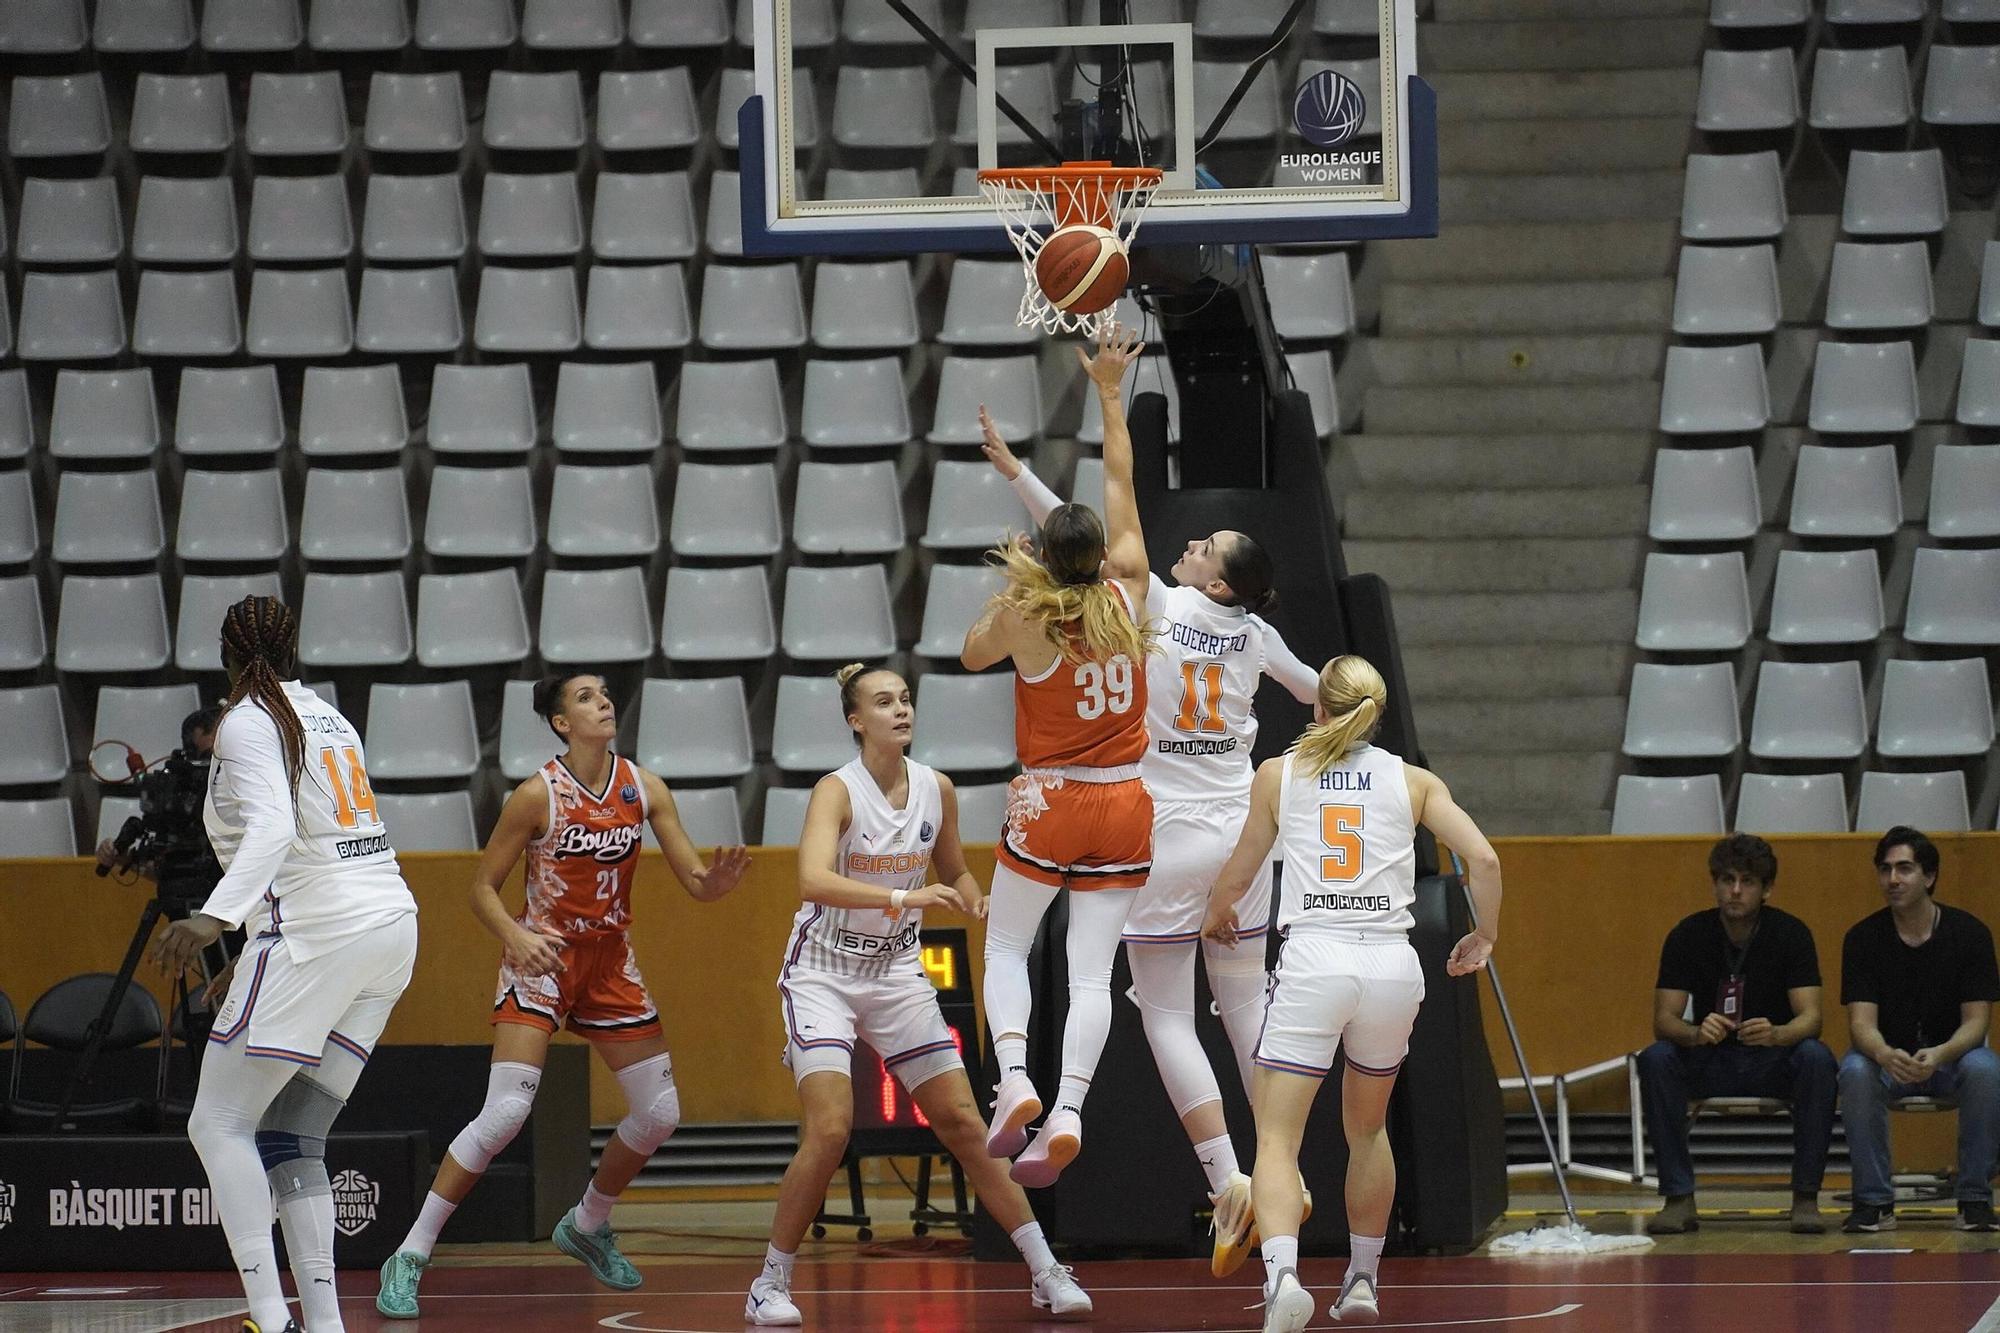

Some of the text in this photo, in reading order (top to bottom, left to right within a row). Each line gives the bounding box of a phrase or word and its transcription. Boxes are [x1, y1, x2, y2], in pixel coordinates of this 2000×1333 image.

[1280, 151, 1381, 168] EUROLEAGUE
[1301, 167, 1361, 182] WOMEN
[1074, 653, 1133, 721] 39
[1172, 660, 1228, 734] 11
[1158, 736, 1238, 756] BAUHAUS
[319, 745, 381, 831] 14
[1319, 771, 1372, 791] HOLM
[555, 822, 642, 863] Bourge
[1319, 803, 1365, 883] 5
[849, 847, 932, 875] GIRON
[596, 867, 619, 901] 21
[1303, 893, 1391, 912] BAUHAUS
[919, 945, 954, 989] 4
[50, 1180, 176, 1231] BÀSQUET
[333, 1203, 377, 1221] IRONA
